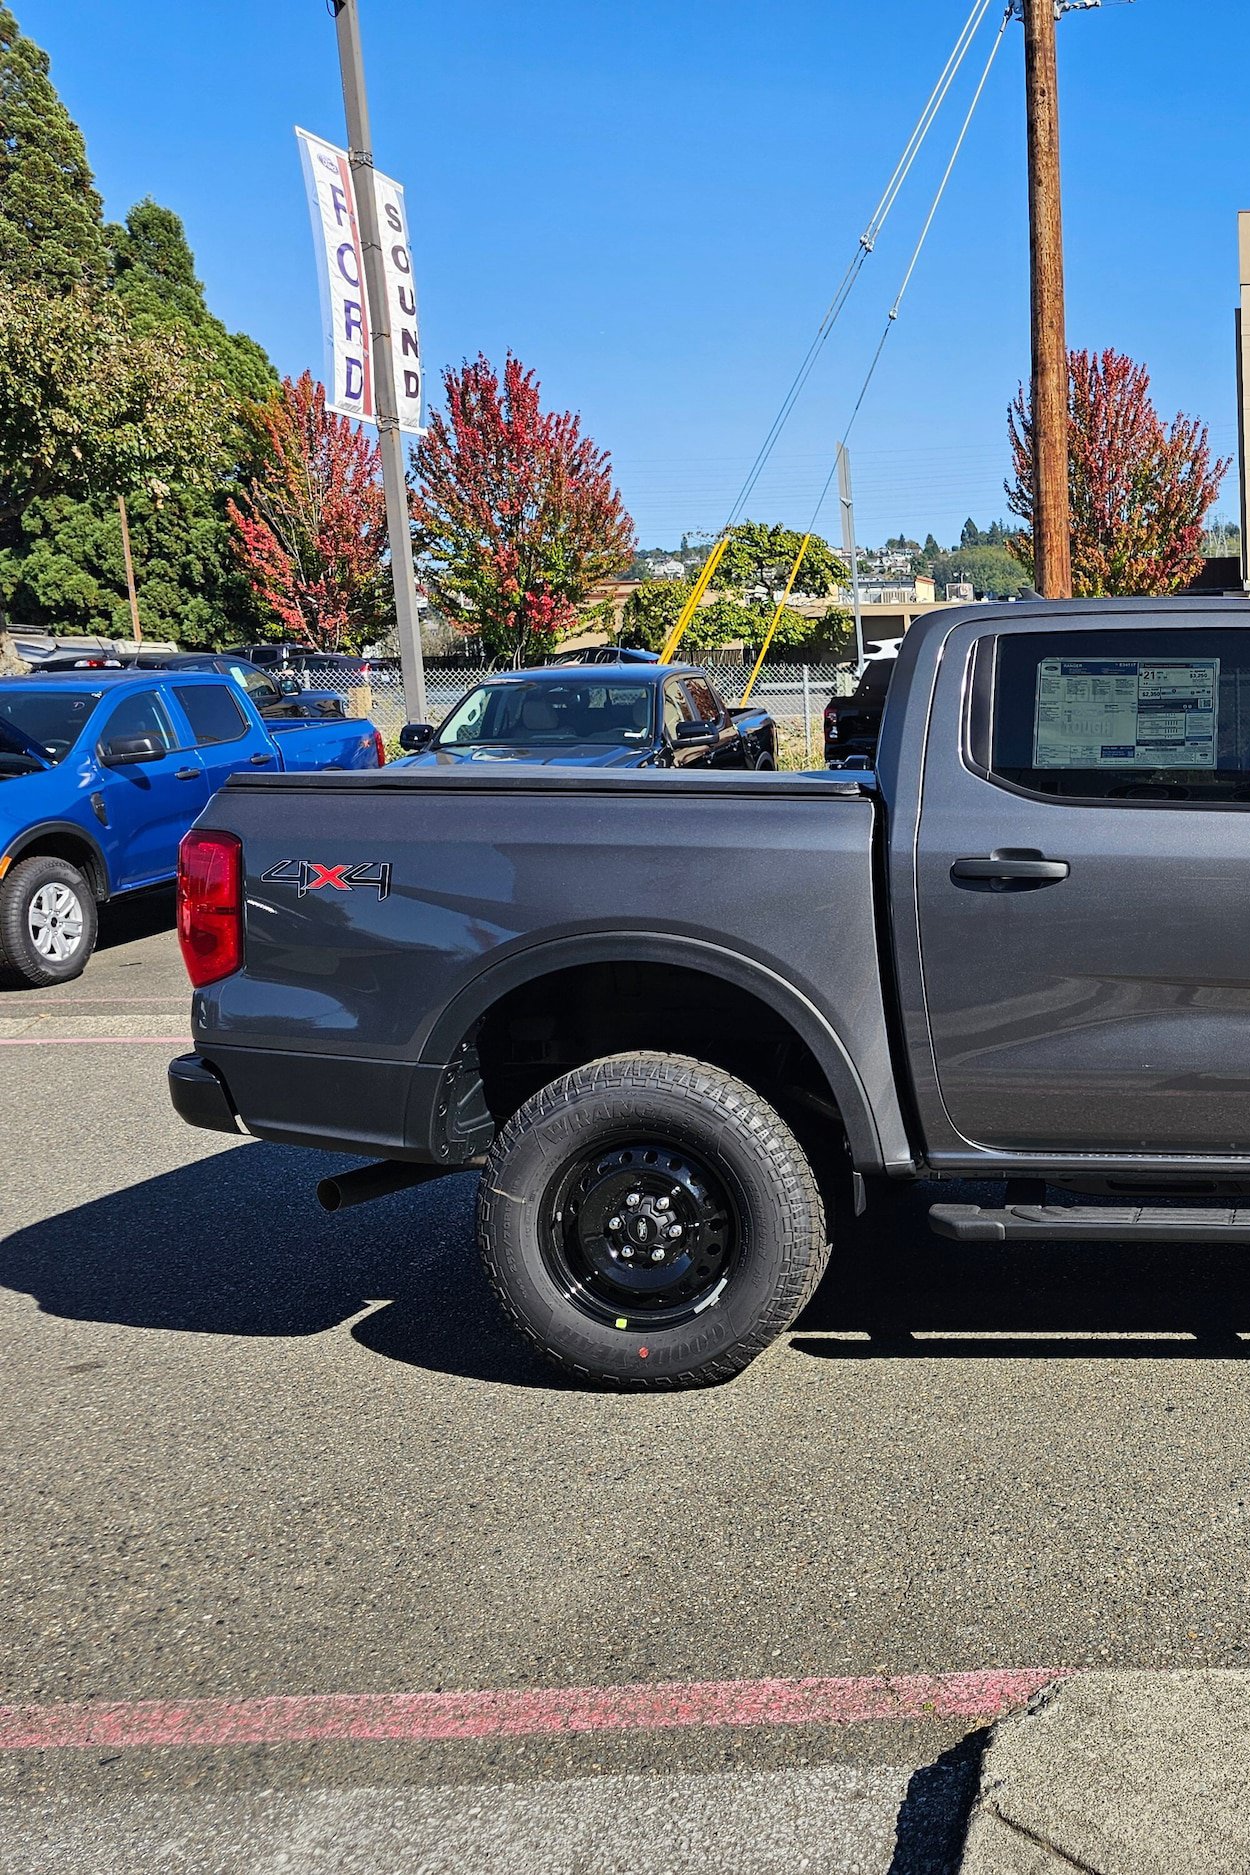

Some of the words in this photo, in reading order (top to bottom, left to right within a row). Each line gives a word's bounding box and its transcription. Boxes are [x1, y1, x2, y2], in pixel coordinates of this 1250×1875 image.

[330, 183, 364, 400] FORD
[384, 202, 419, 399] SOUND
[1143, 671, 1155, 680] 21
